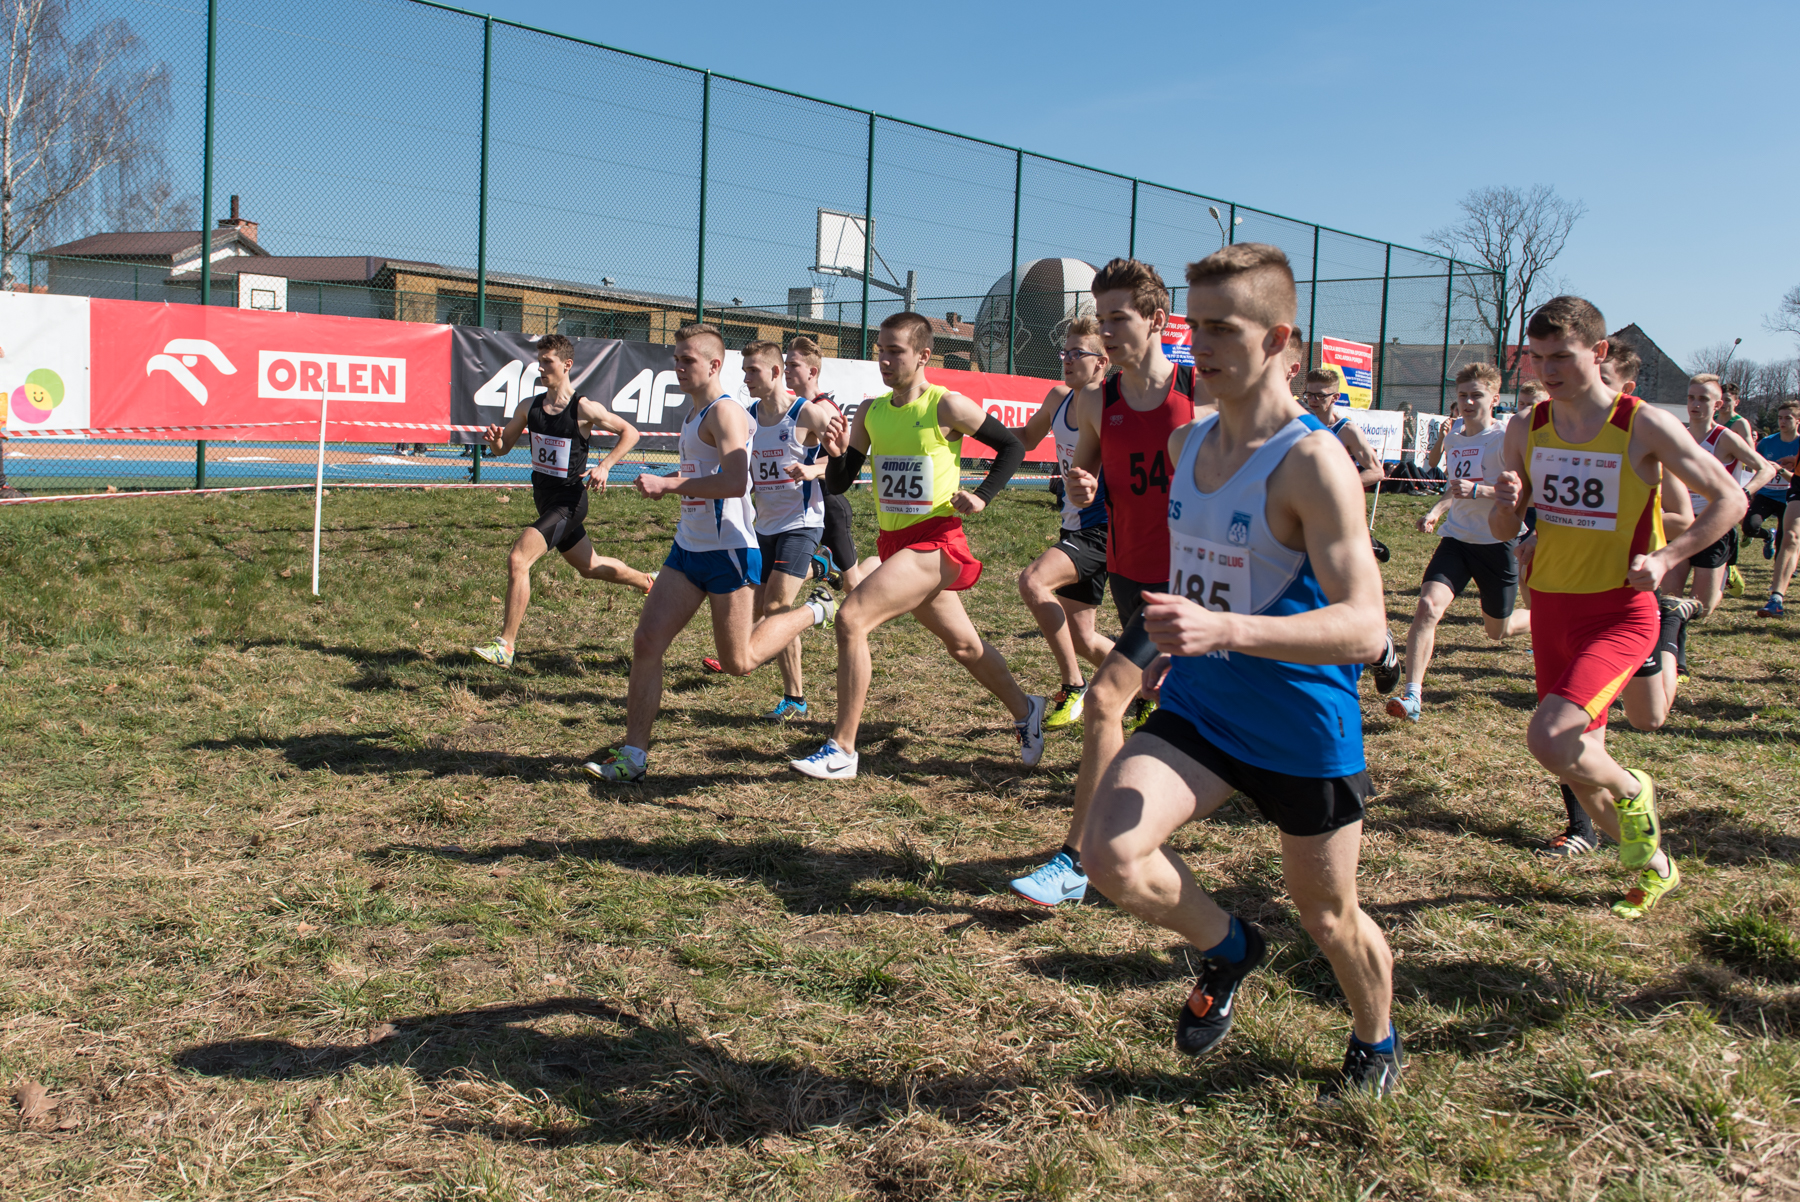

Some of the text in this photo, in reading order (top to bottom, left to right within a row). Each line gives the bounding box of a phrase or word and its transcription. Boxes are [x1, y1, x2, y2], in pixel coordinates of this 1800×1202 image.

[267, 358, 396, 395] ORLEN
[474, 359, 548, 418] 4F
[612, 369, 687, 424] 4F
[986, 404, 1041, 428] ORLE
[546, 439, 564, 447] ORLEN
[538, 448, 557, 465] 84
[882, 461, 922, 472] 4MOVE
[1603, 461, 1617, 469] LUG
[760, 461, 779, 480] 54
[1130, 450, 1169, 495] 54
[1455, 460, 1471, 478] 62
[882, 474, 924, 499] 245
[1543, 474, 1605, 508] 538
[1545, 514, 1596, 527] OLSZYNA 2019
[1227, 556, 1244, 568] LUG
[1171, 569, 1231, 612] 485
